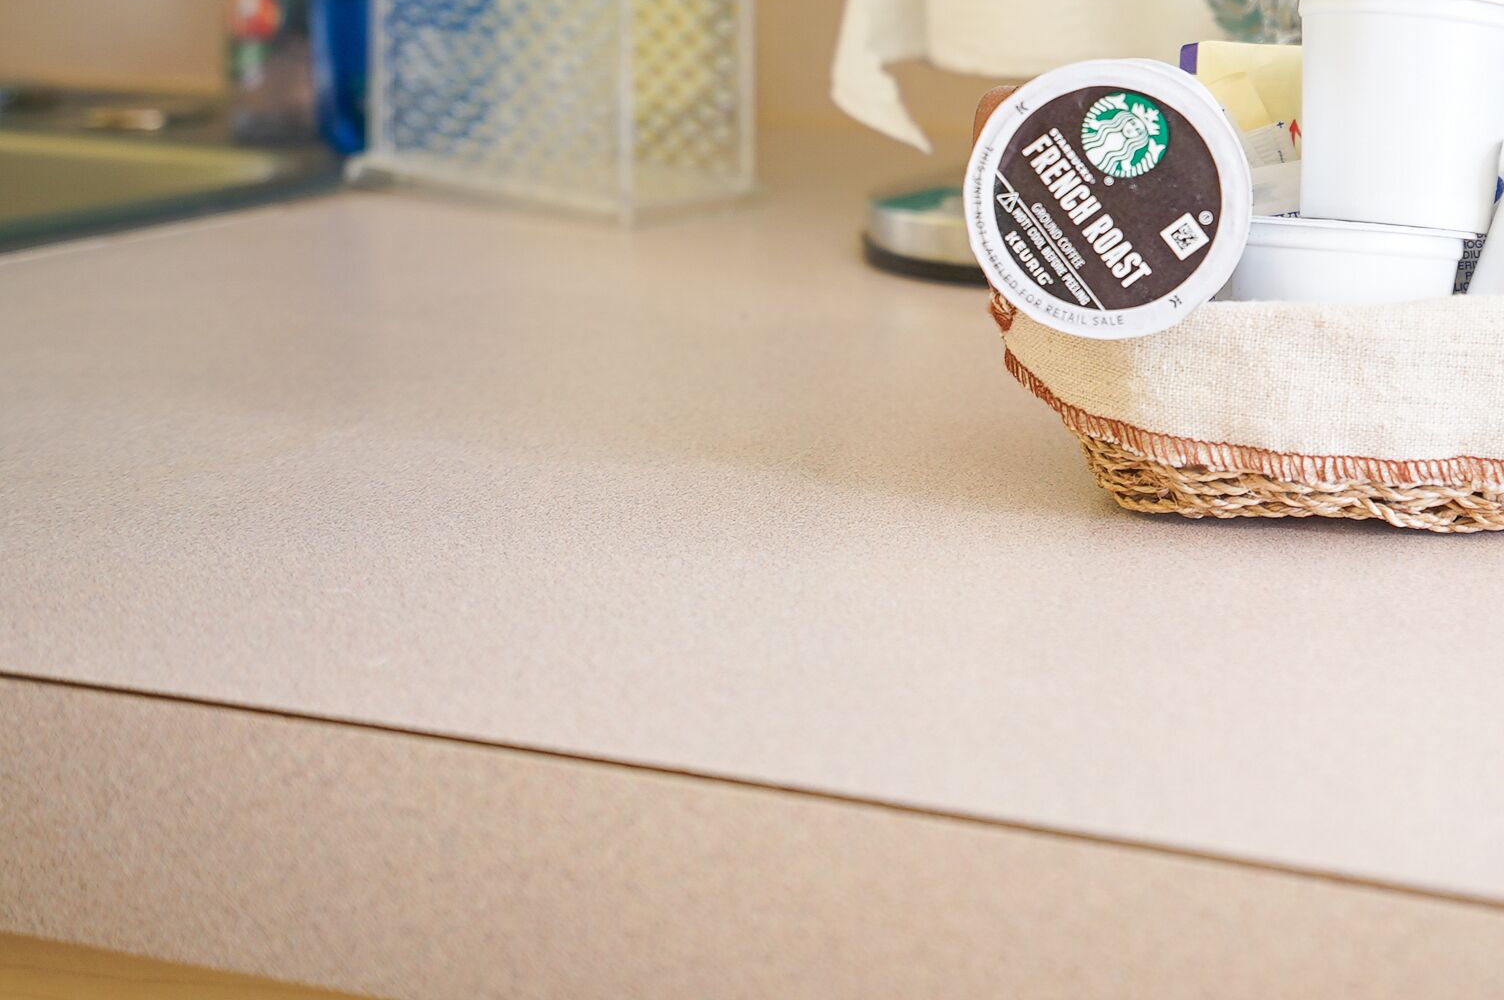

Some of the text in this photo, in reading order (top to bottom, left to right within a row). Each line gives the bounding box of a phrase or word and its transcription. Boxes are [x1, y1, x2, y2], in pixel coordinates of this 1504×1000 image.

[1048, 127, 1094, 184] STARBUCKS
[1021, 133, 1152, 289] FRENCH ROAST
[1030, 202, 1087, 270] GROUND COFFEE
[981, 240, 1018, 289] LABELED
[1017, 288, 1043, 309] FOR
[1043, 305, 1088, 325] RETAIL
[1092, 315, 1125, 326] SALE
[1004, 230, 1054, 286] KEURIG
[1027, 225, 1046, 250] COOL
[1041, 245, 1068, 277] BEFORE
[1061, 272, 1092, 307] PEELING
